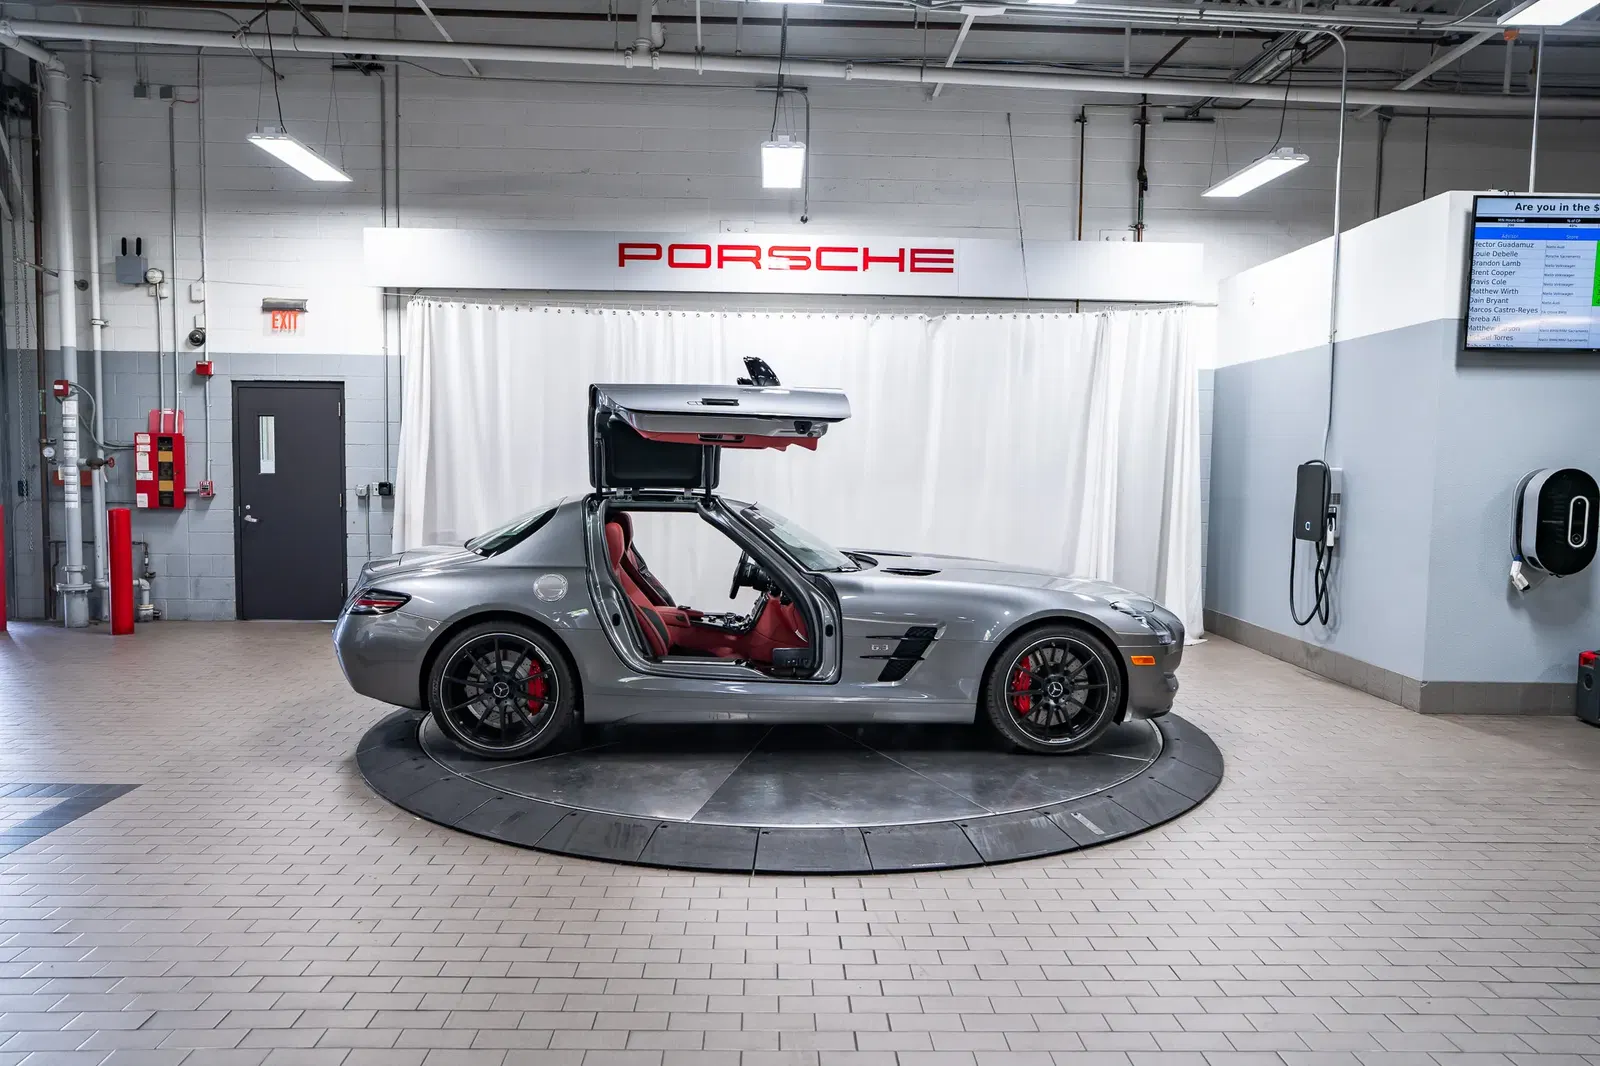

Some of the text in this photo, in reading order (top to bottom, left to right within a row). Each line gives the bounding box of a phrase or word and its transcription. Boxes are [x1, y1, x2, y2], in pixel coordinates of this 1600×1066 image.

[1514, 202, 1600, 213] Are you in the $
[618, 243, 954, 273] PORSCHE
[272, 310, 299, 329] EXIT
